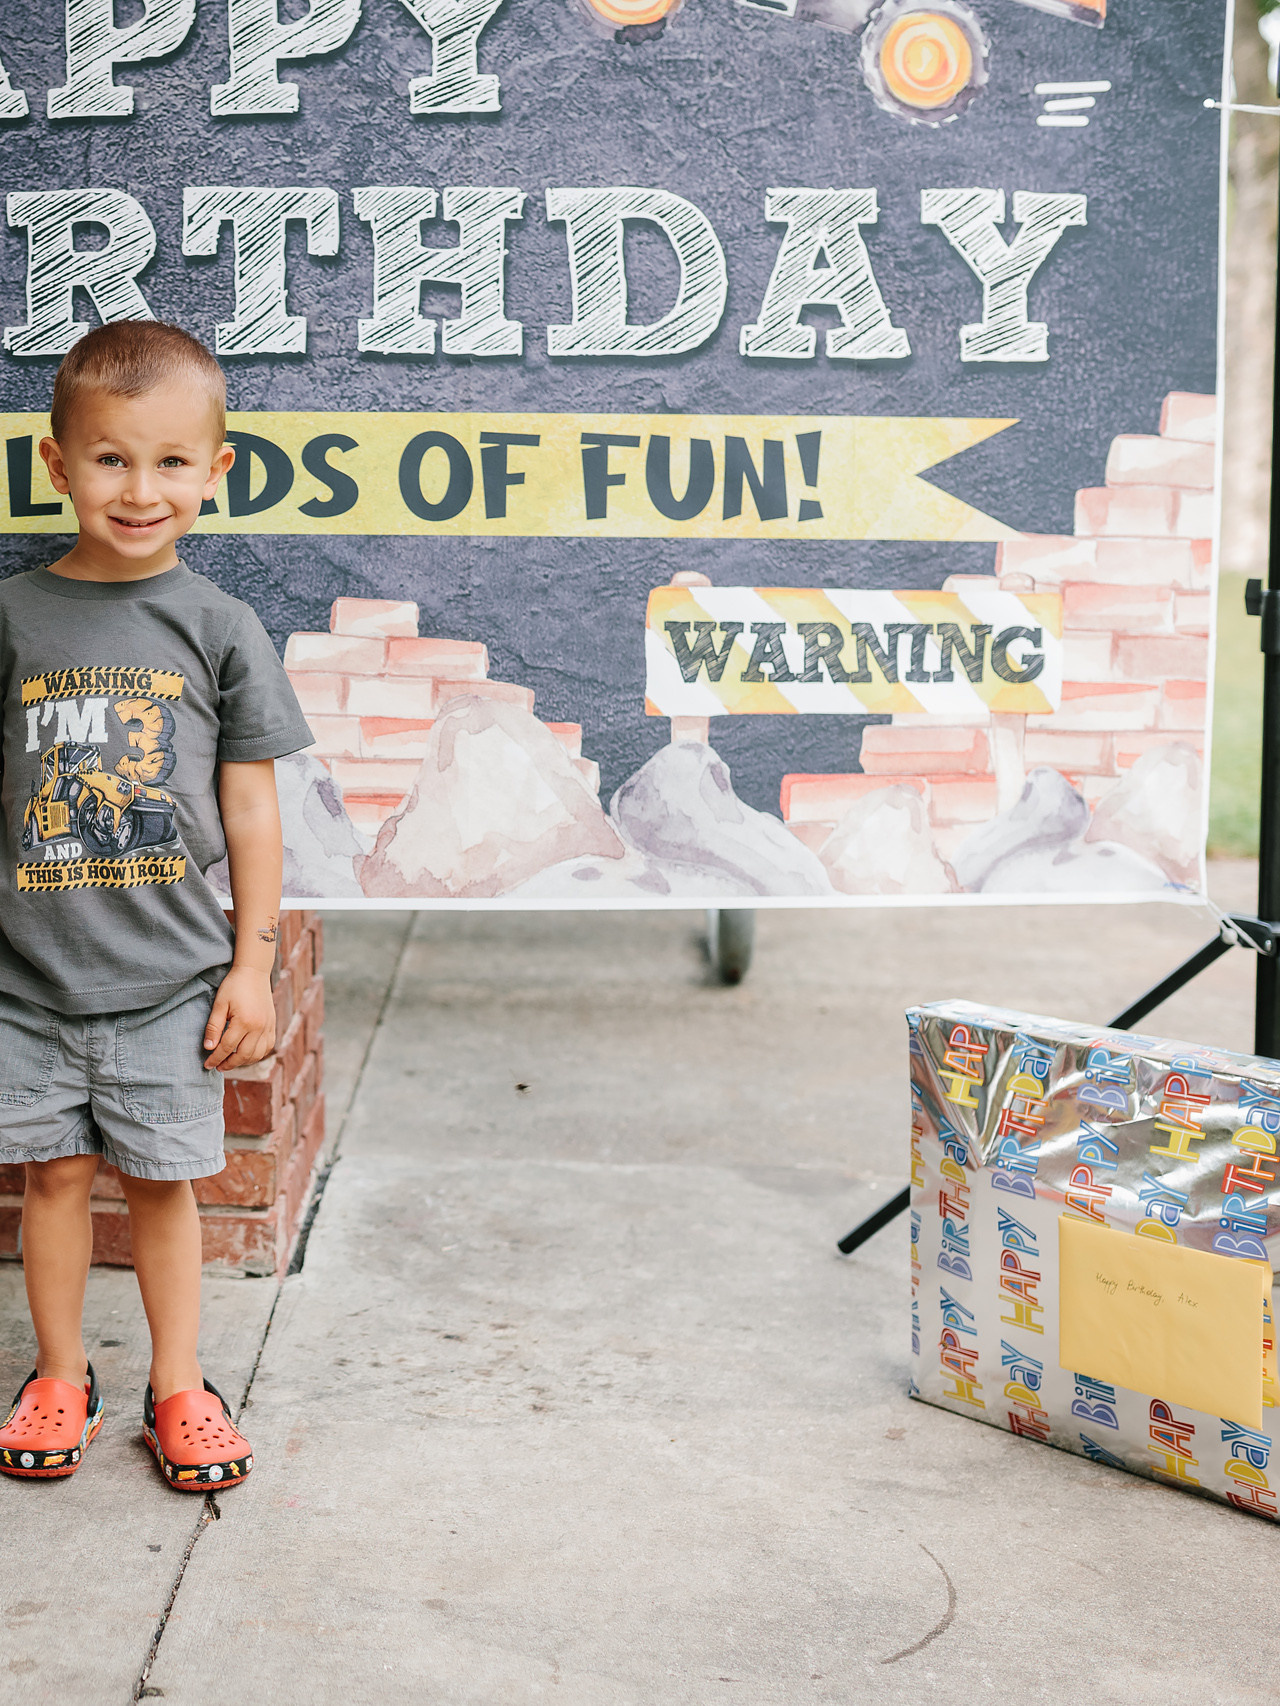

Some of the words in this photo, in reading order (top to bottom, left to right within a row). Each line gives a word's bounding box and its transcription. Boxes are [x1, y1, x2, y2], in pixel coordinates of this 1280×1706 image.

[6, 430, 360, 518] LDS
[398, 431, 538, 522] OF
[580, 430, 822, 522] FUN!
[664, 619, 1045, 686] WARNING
[44, 672, 152, 694] WARNING
[25, 698, 109, 752] I'M
[113, 698, 178, 786] 3
[43, 842, 83, 861] AND
[25, 868, 63, 885] THIS
[67, 866, 83, 882] IS
[87, 864, 126, 880] HOW
[130, 866, 135, 880] I
[137, 863, 177, 879] ROLL
[1096, 1272, 1118, 1296] Happy
[1177, 1292, 1199, 1309] Alex
